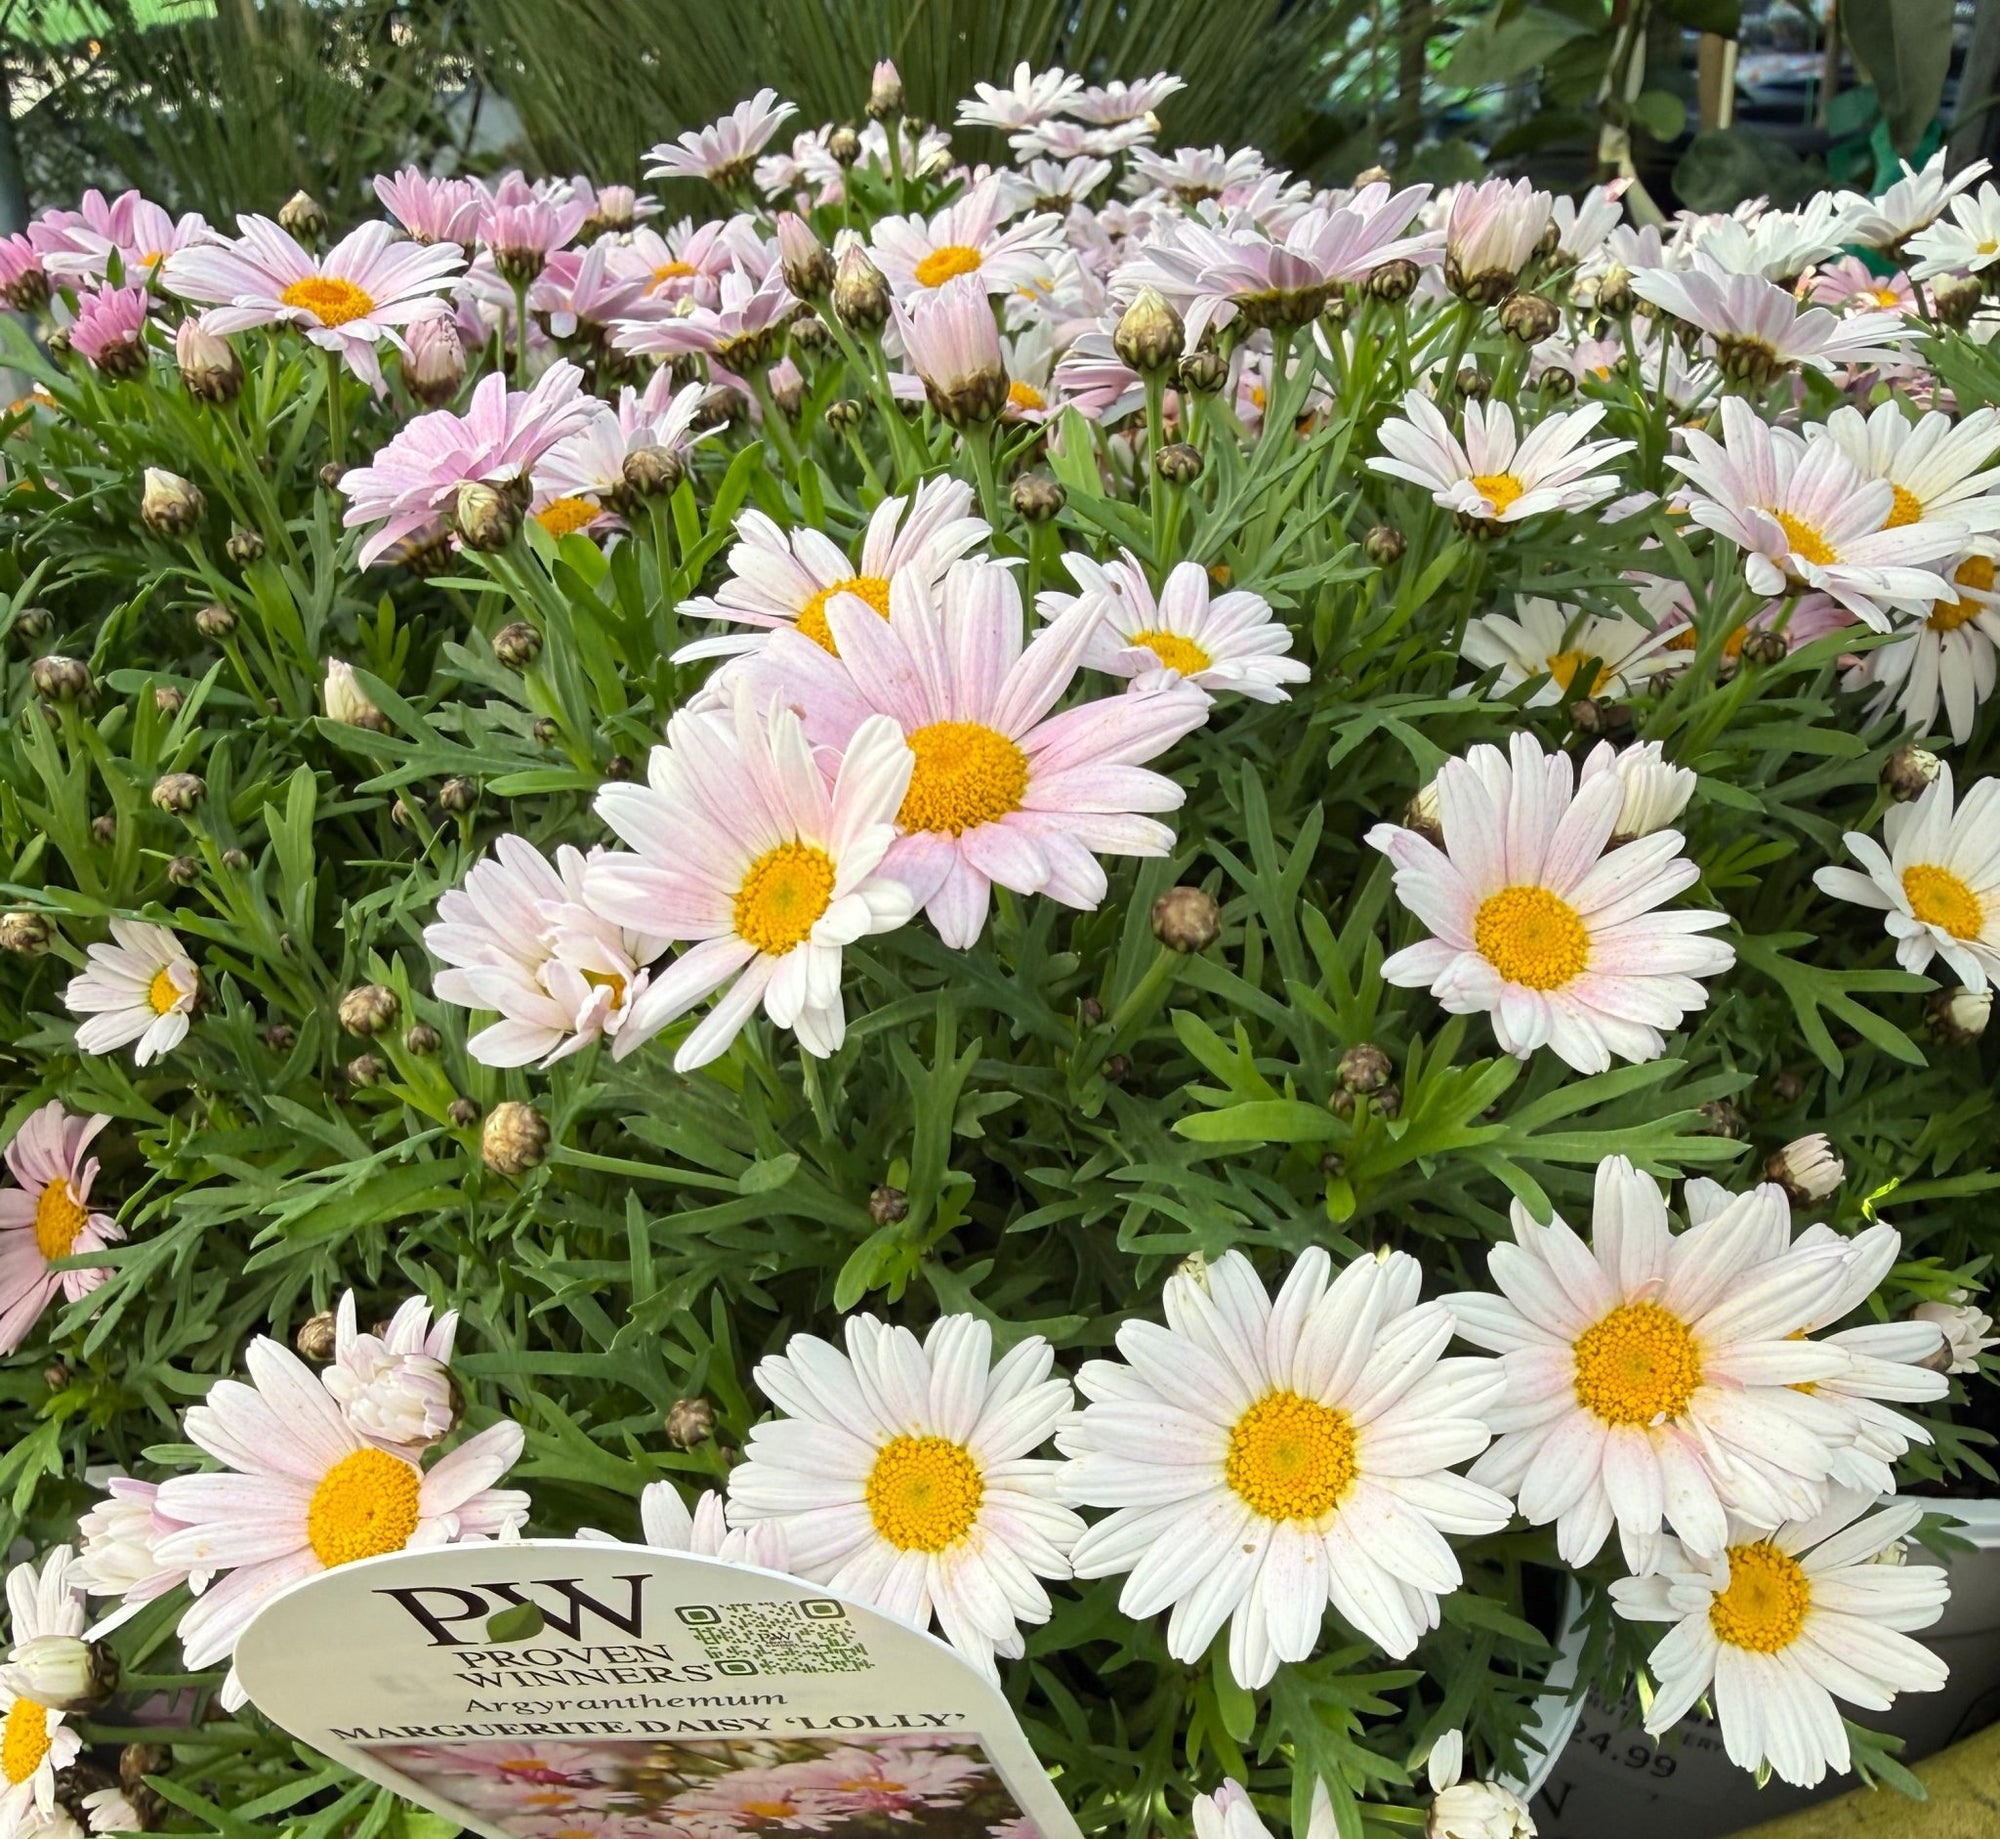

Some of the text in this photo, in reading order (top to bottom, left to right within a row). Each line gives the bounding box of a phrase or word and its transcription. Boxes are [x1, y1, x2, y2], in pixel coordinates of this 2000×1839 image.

[372, 1574, 653, 1646] PW
[453, 1644, 674, 1669] PROVEN
[465, 1692, 787, 1715] Argyranthemum
[329, 1720, 631, 1740] MARGUERITE
[634, 1717, 772, 1733] DAISY
